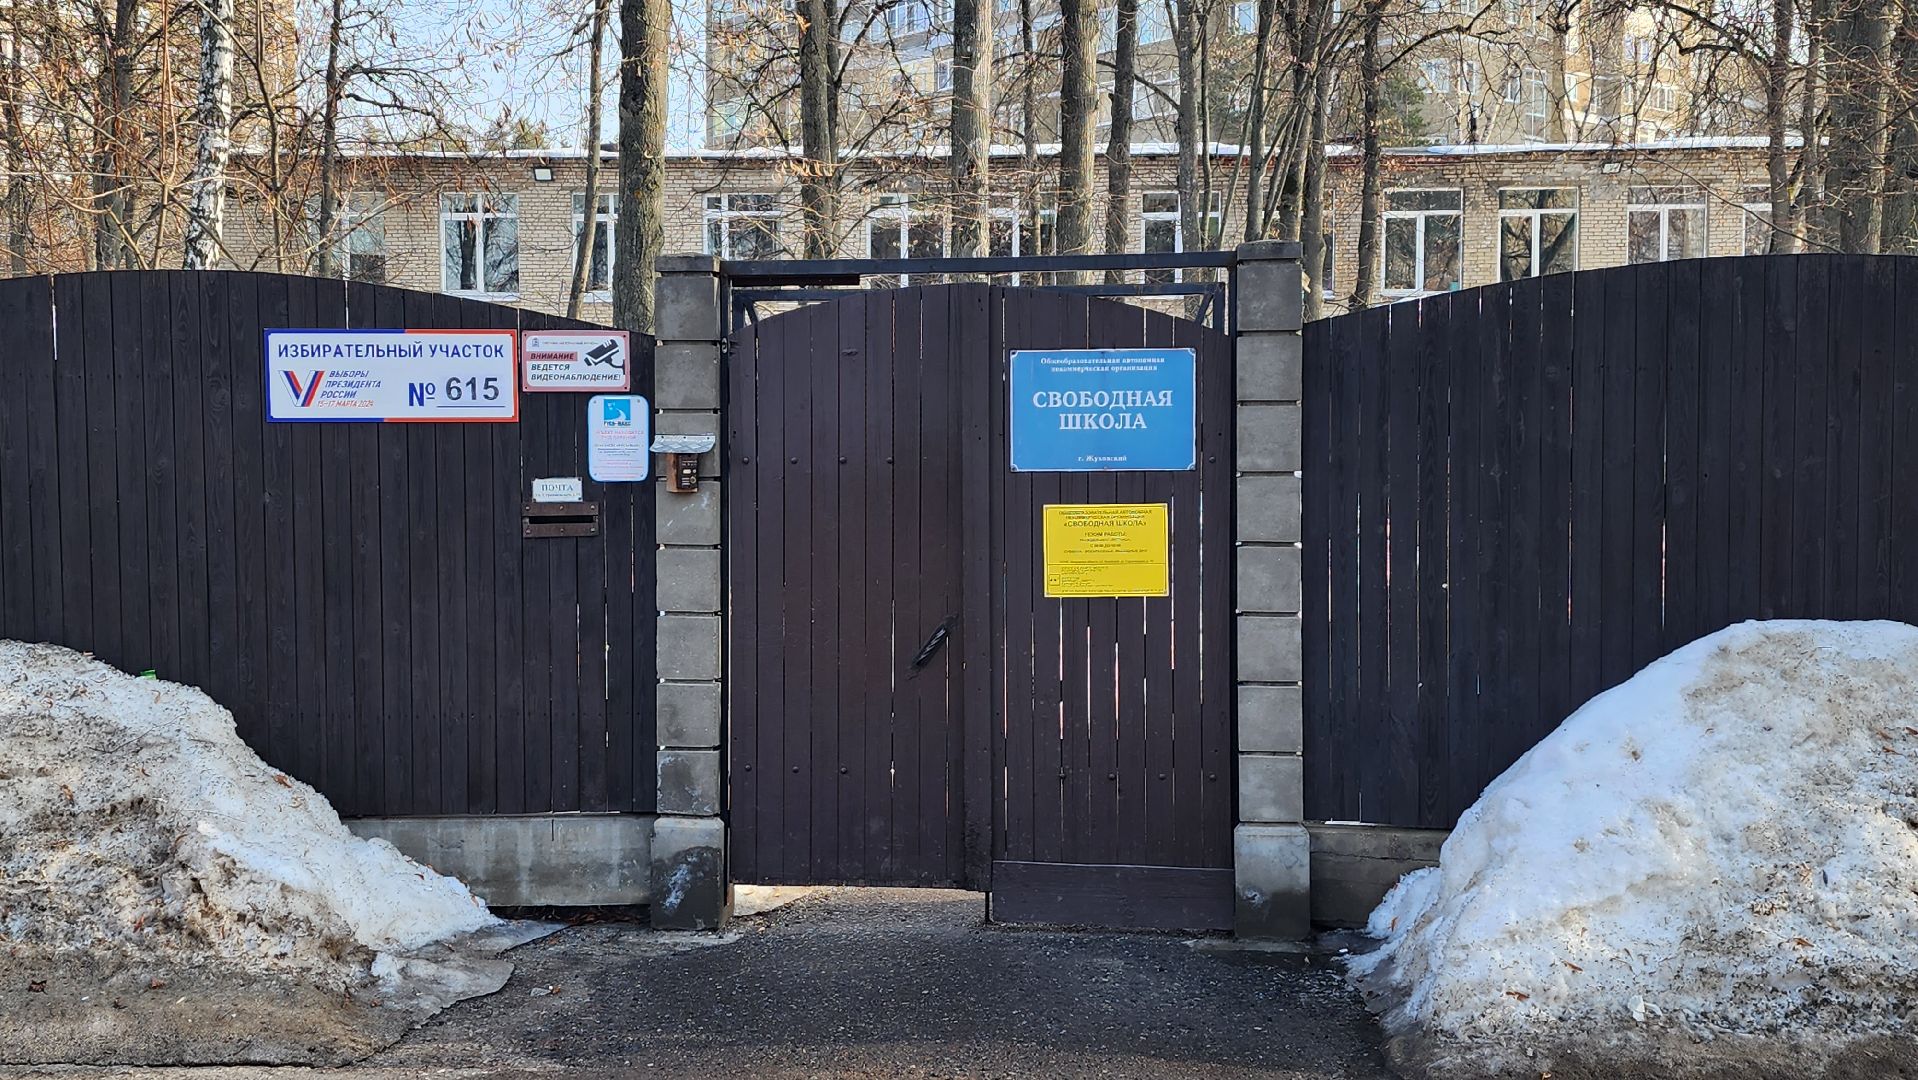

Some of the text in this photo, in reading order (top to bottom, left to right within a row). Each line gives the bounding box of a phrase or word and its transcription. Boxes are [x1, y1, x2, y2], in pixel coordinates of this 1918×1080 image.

[278, 341, 504, 358] ИЗБИРАТЕЛЬНЫЙ УЧАСТОК
[329, 370, 369, 378] ВЫБОРЫ
[531, 373, 621, 382] ВИДЕОНАБЛЮДЕНИЕ!
[325, 380, 382, 389] ПРЕЗИДЕНТА
[320, 390, 357, 398] РОССИИ
[409, 377, 500, 407] № 615
[1032, 390, 1173, 410] СВОБОДНАЯ
[1059, 413, 1147, 430] ШКОЛА
[541, 484, 574, 492] ПОЧТА
[1064, 520, 1114, 528] «СВОБОДНАЯ
